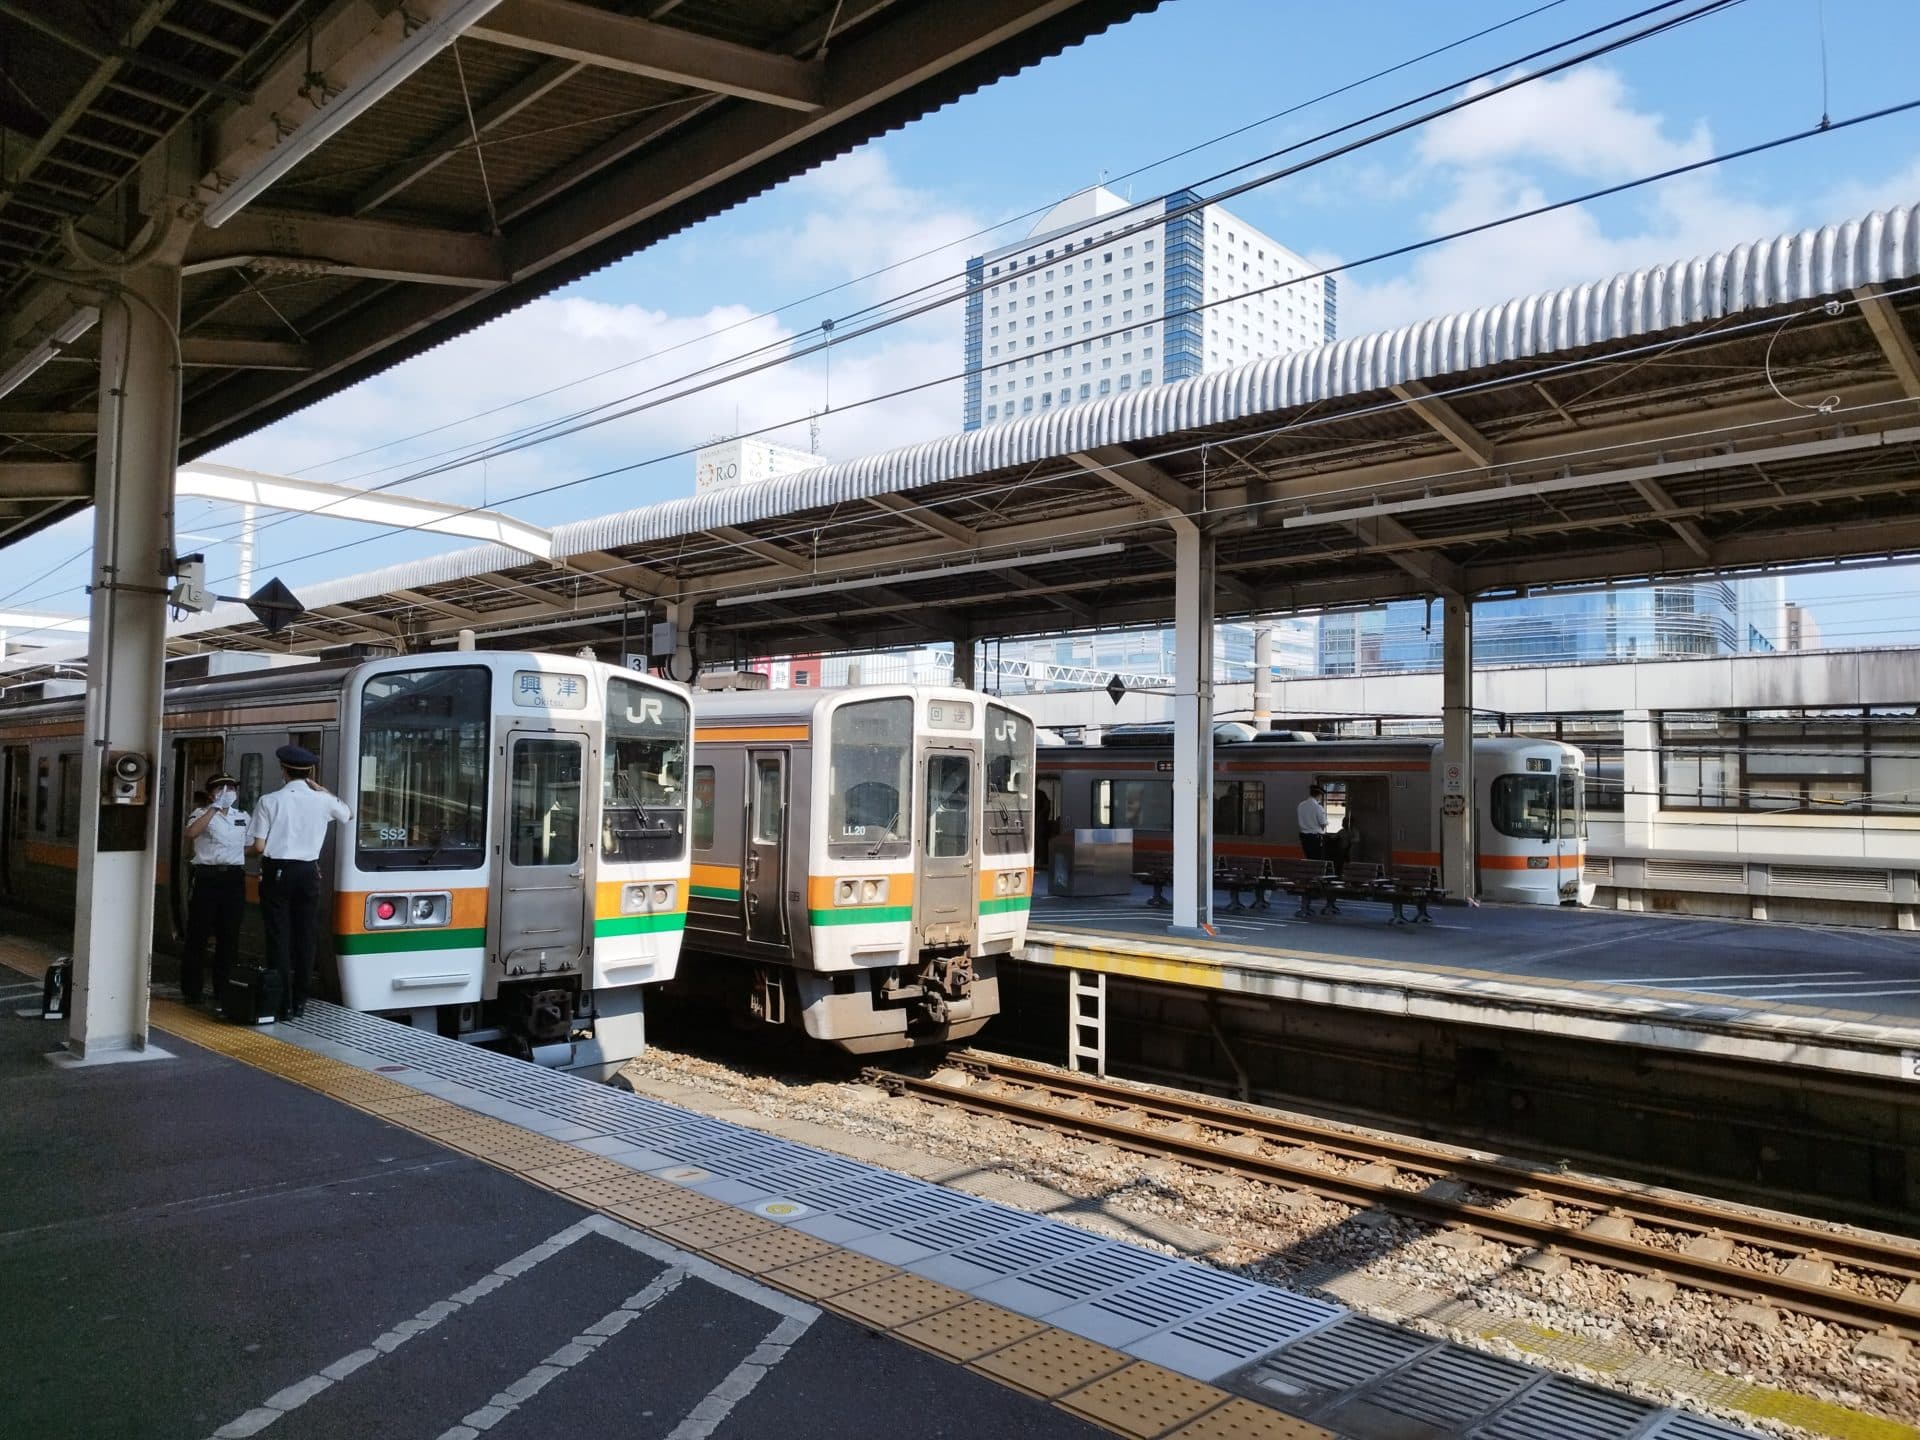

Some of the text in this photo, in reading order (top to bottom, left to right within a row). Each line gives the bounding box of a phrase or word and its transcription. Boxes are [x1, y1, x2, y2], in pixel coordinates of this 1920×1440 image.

[632, 658, 642, 673] 3
[520, 674, 578, 697] 興津
[626, 697, 663, 725] JR
[930, 706, 966, 723] 回送
[995, 720, 1017, 742] JR
[380, 828, 406, 840] SS2
[842, 825, 866, 836] LL20
